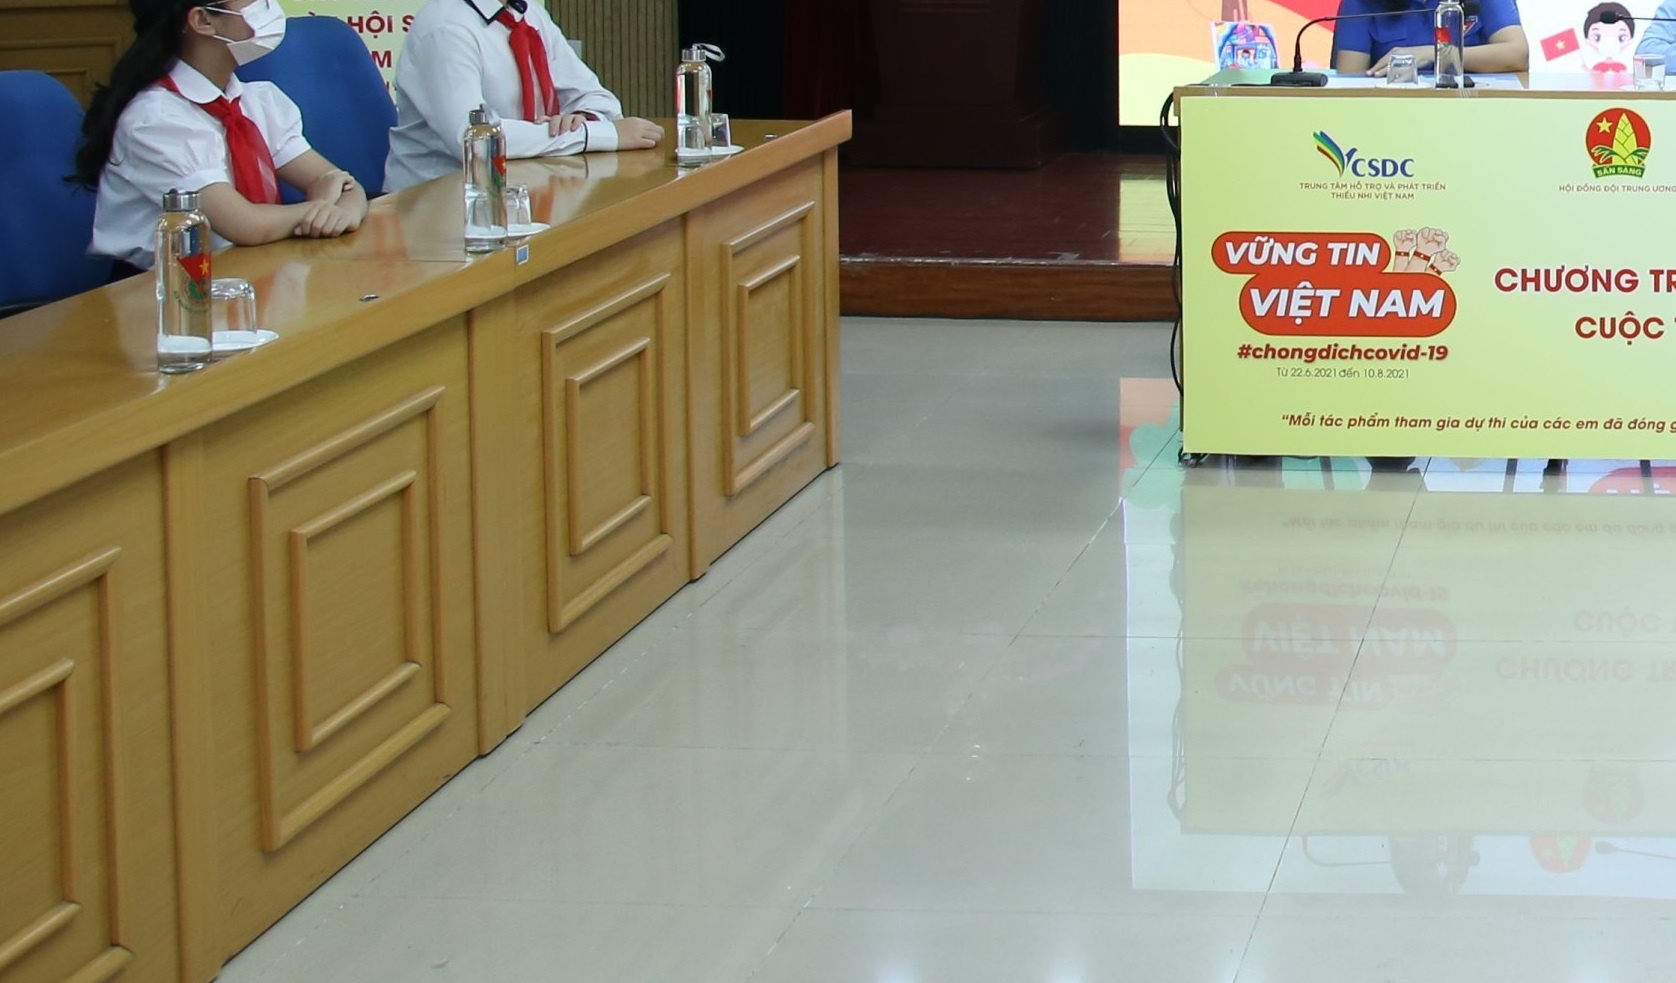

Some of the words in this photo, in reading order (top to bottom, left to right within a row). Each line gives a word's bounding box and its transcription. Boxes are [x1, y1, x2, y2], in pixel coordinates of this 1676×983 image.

[1300, 182, 1328, 190] TRUNG
[1330, 181, 1347, 190] TÂM
[1384, 181, 1395, 190] VÀ
[1398, 181, 1418, 191] PHÁT
[1224, 235, 1318, 265] VỮNG
[1327, 242, 1380, 266] TIN
[1495, 265, 1639, 293] CHƯƠNG
[1250, 281, 1340, 325] VIỆT
[1348, 288, 1445, 318] NAM
[1575, 311, 1664, 345] CUỘC
[1237, 343, 1448, 363] #chongdichcovid-19
[1290, 367, 1337, 379] 22.6.2021
[1363, 368, 1410, 379] 10.8.2021
[1320, 415, 1343, 426] tác
[1395, 417, 1431, 427] tham
[1436, 417, 1460, 431] gia
[1465, 417, 1485, 431] dự
[1489, 417, 1506, 428] thi
[1511, 416, 1538, 429] của
[1543, 417, 1571, 429] các
[1576, 421, 1598, 429] em
[1603, 418, 1623, 429] đã
[1628, 418, 1665, 433] đóng
